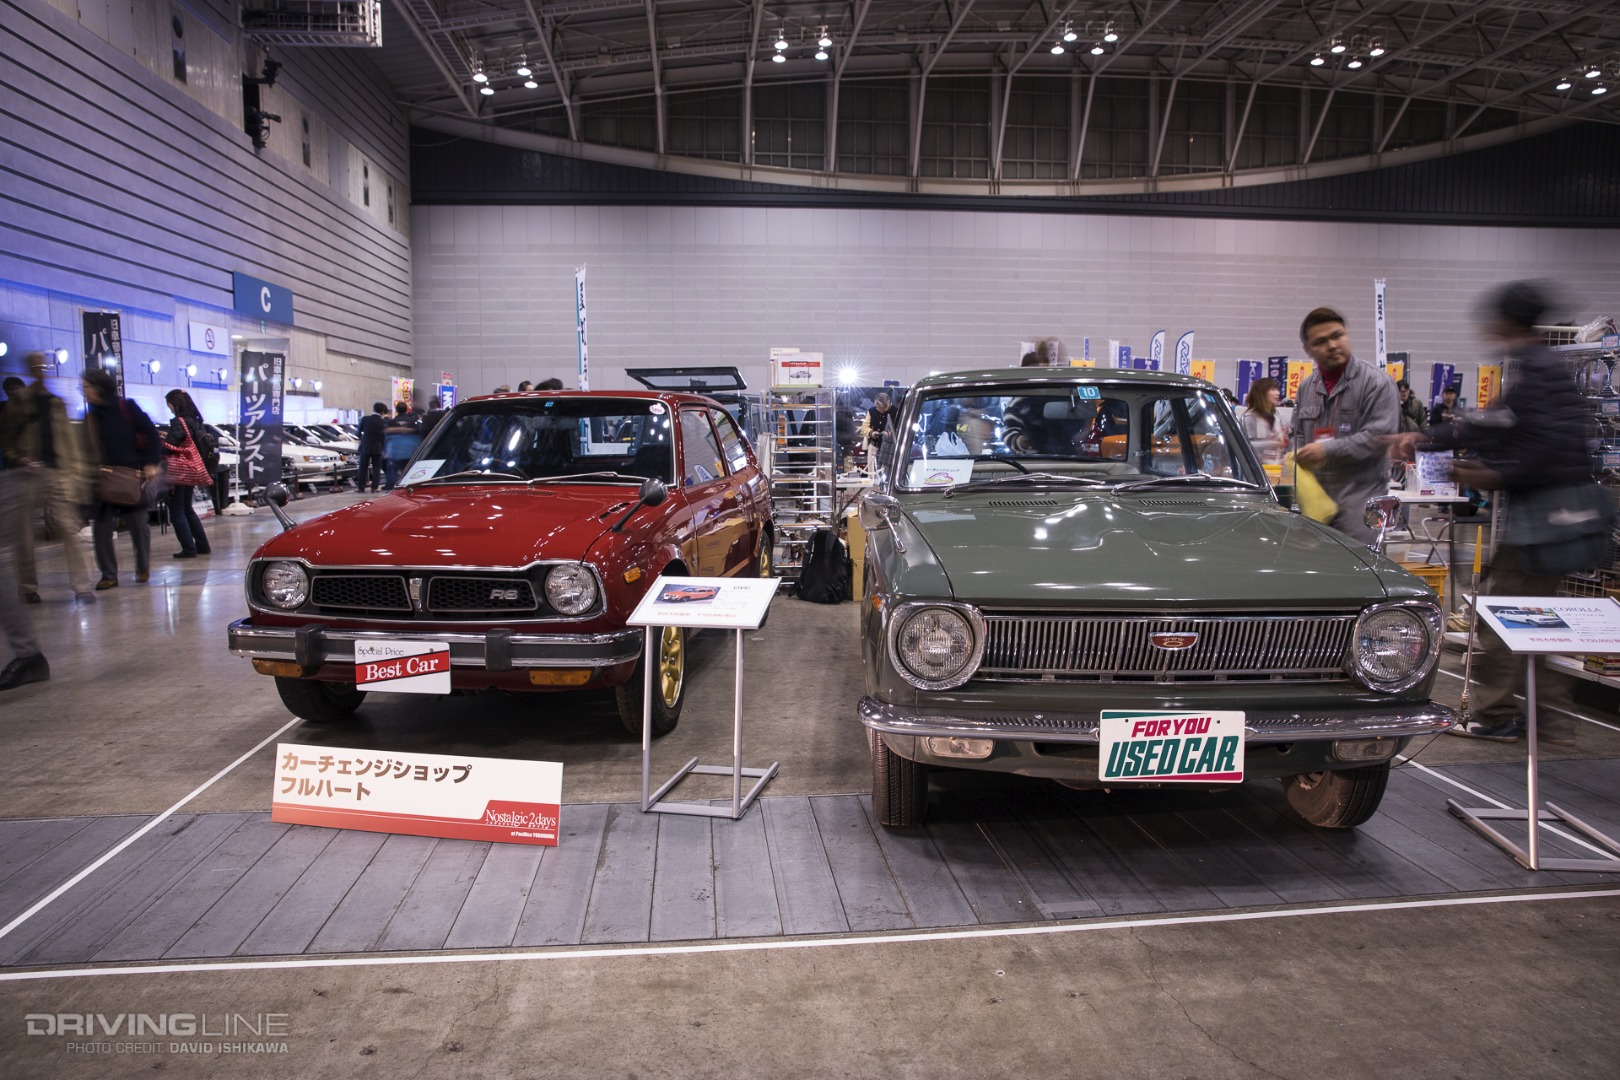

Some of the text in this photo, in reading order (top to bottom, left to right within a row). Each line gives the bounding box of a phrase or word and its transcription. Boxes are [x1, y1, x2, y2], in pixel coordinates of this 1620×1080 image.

[260, 286, 272, 313] C
[1081, 387, 1096, 397] 10
[244, 363, 269, 479] パーツアシスト
[490, 589, 518, 600] RS
[357, 645, 404, 656] Special Price
[365, 657, 439, 681] Best Car
[281, 752, 473, 783] カーチェンジショップ
[1104, 735, 1239, 777] USED CAR
[280, 776, 371, 801] フルハート
[485, 809, 556, 829] Nostalgic 2days
